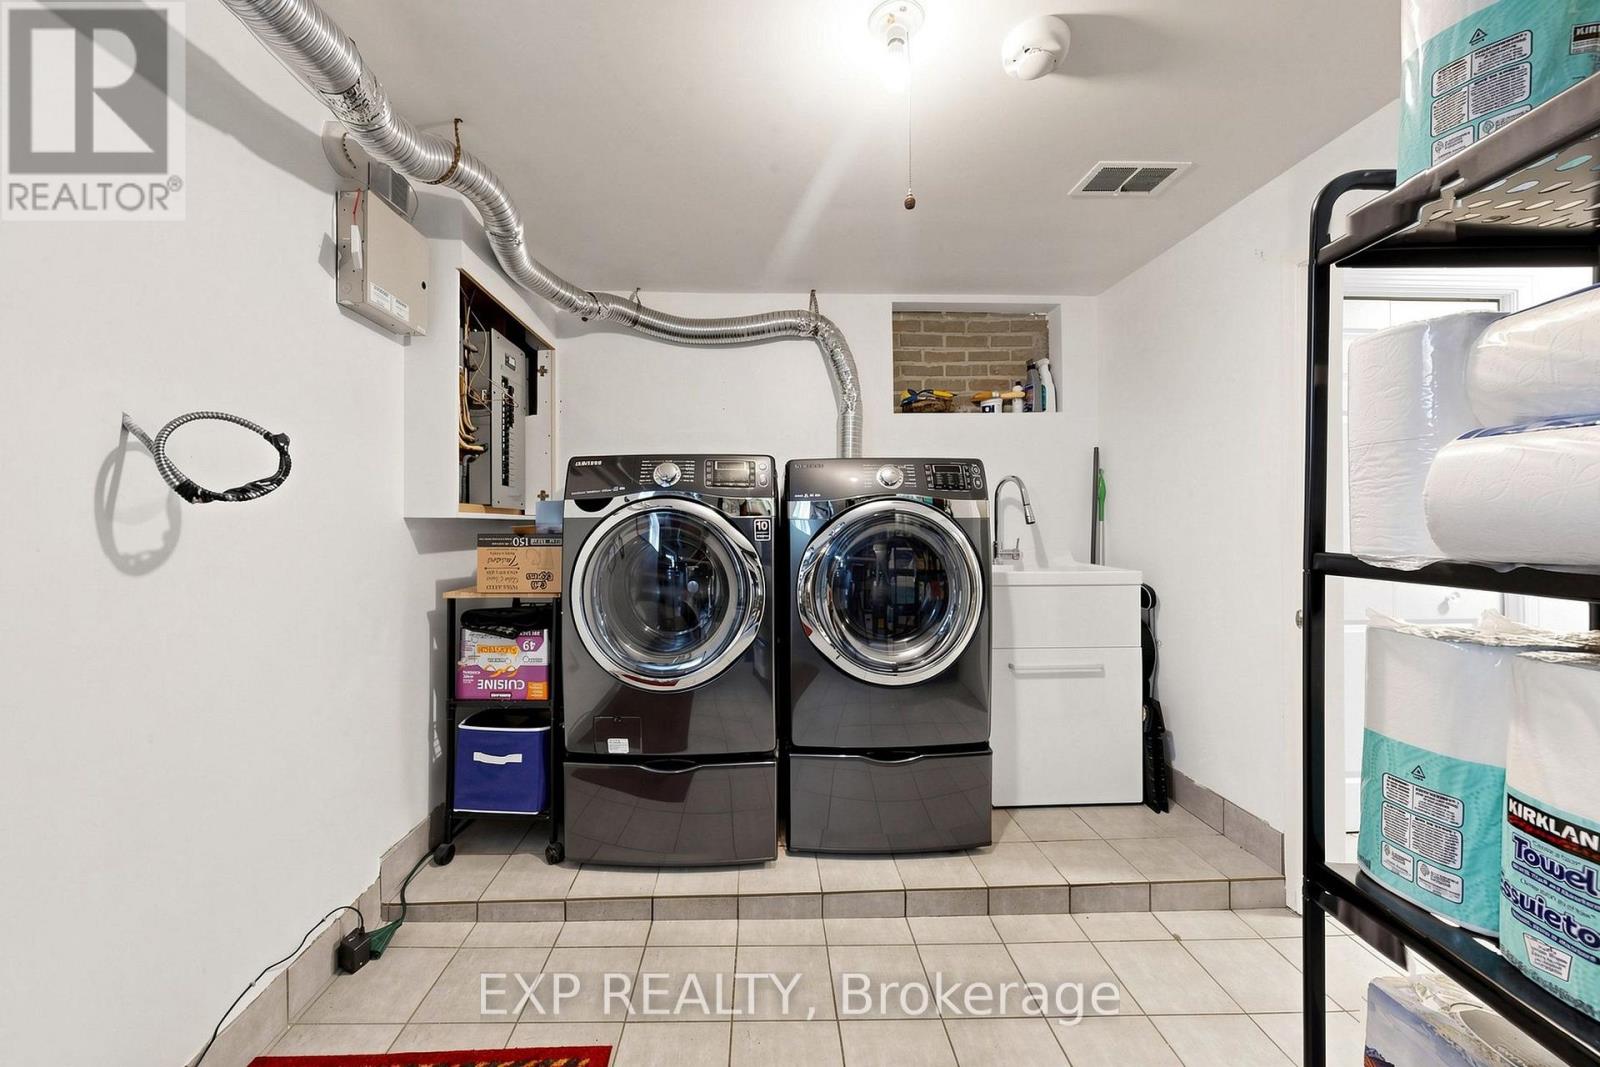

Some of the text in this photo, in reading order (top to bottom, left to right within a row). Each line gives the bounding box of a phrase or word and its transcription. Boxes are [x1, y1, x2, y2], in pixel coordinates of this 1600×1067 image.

[756, 520, 768, 530] 10
[512, 537, 529, 547] 150
[522, 640, 536, 651] 49
[477, 679, 525, 690] CUISINE
[1512, 832, 1600, 899] Towel
[1500, 874, 1600, 950] ssuieto
